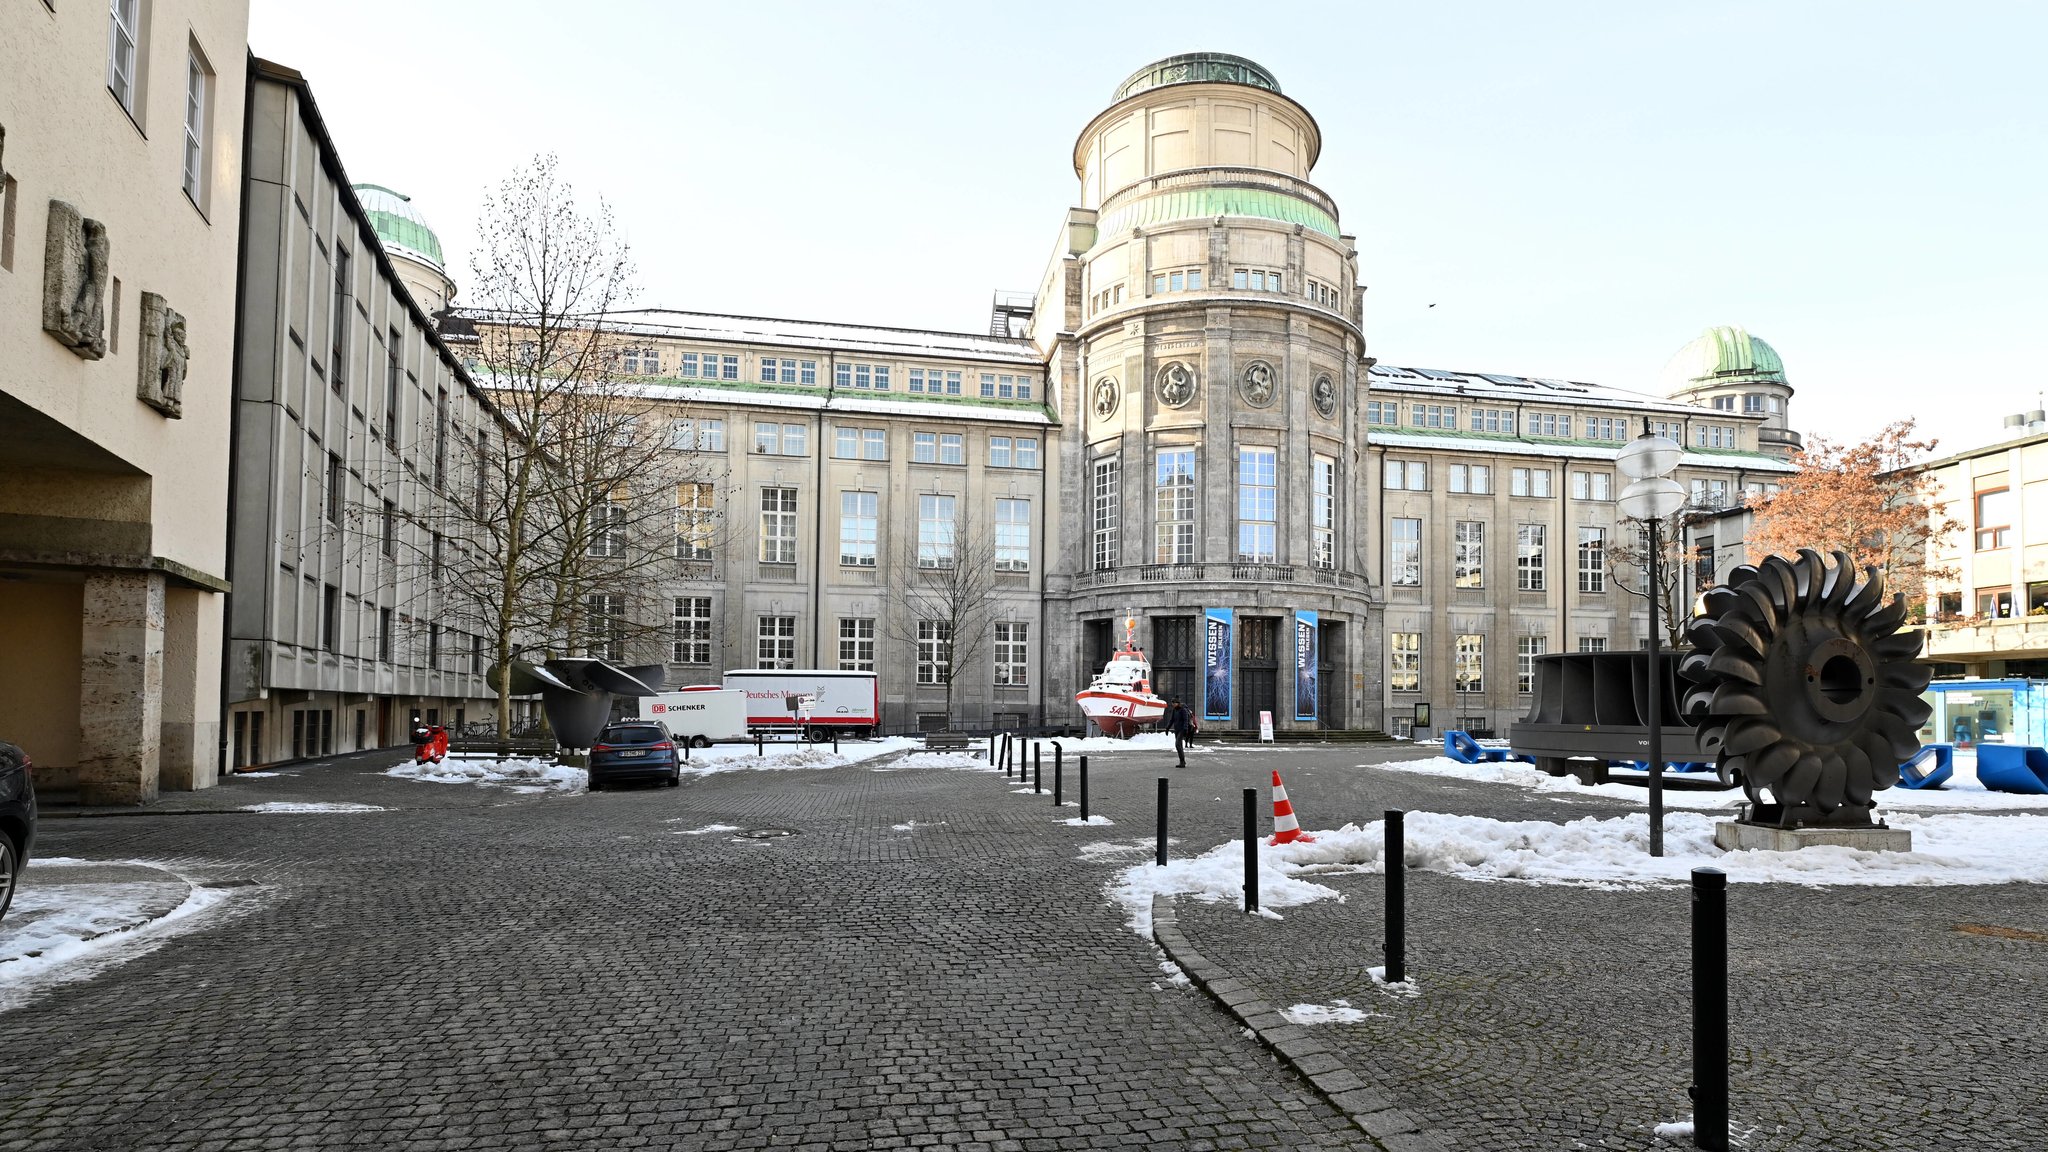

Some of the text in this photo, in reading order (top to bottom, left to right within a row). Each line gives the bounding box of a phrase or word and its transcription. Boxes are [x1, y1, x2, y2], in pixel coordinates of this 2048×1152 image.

[1208, 622, 1217, 667] WISSEN
[1298, 624, 1306, 668] WISSEN
[668, 704, 706, 712] SCHENKER
[1109, 705, 1128, 716] SAR
